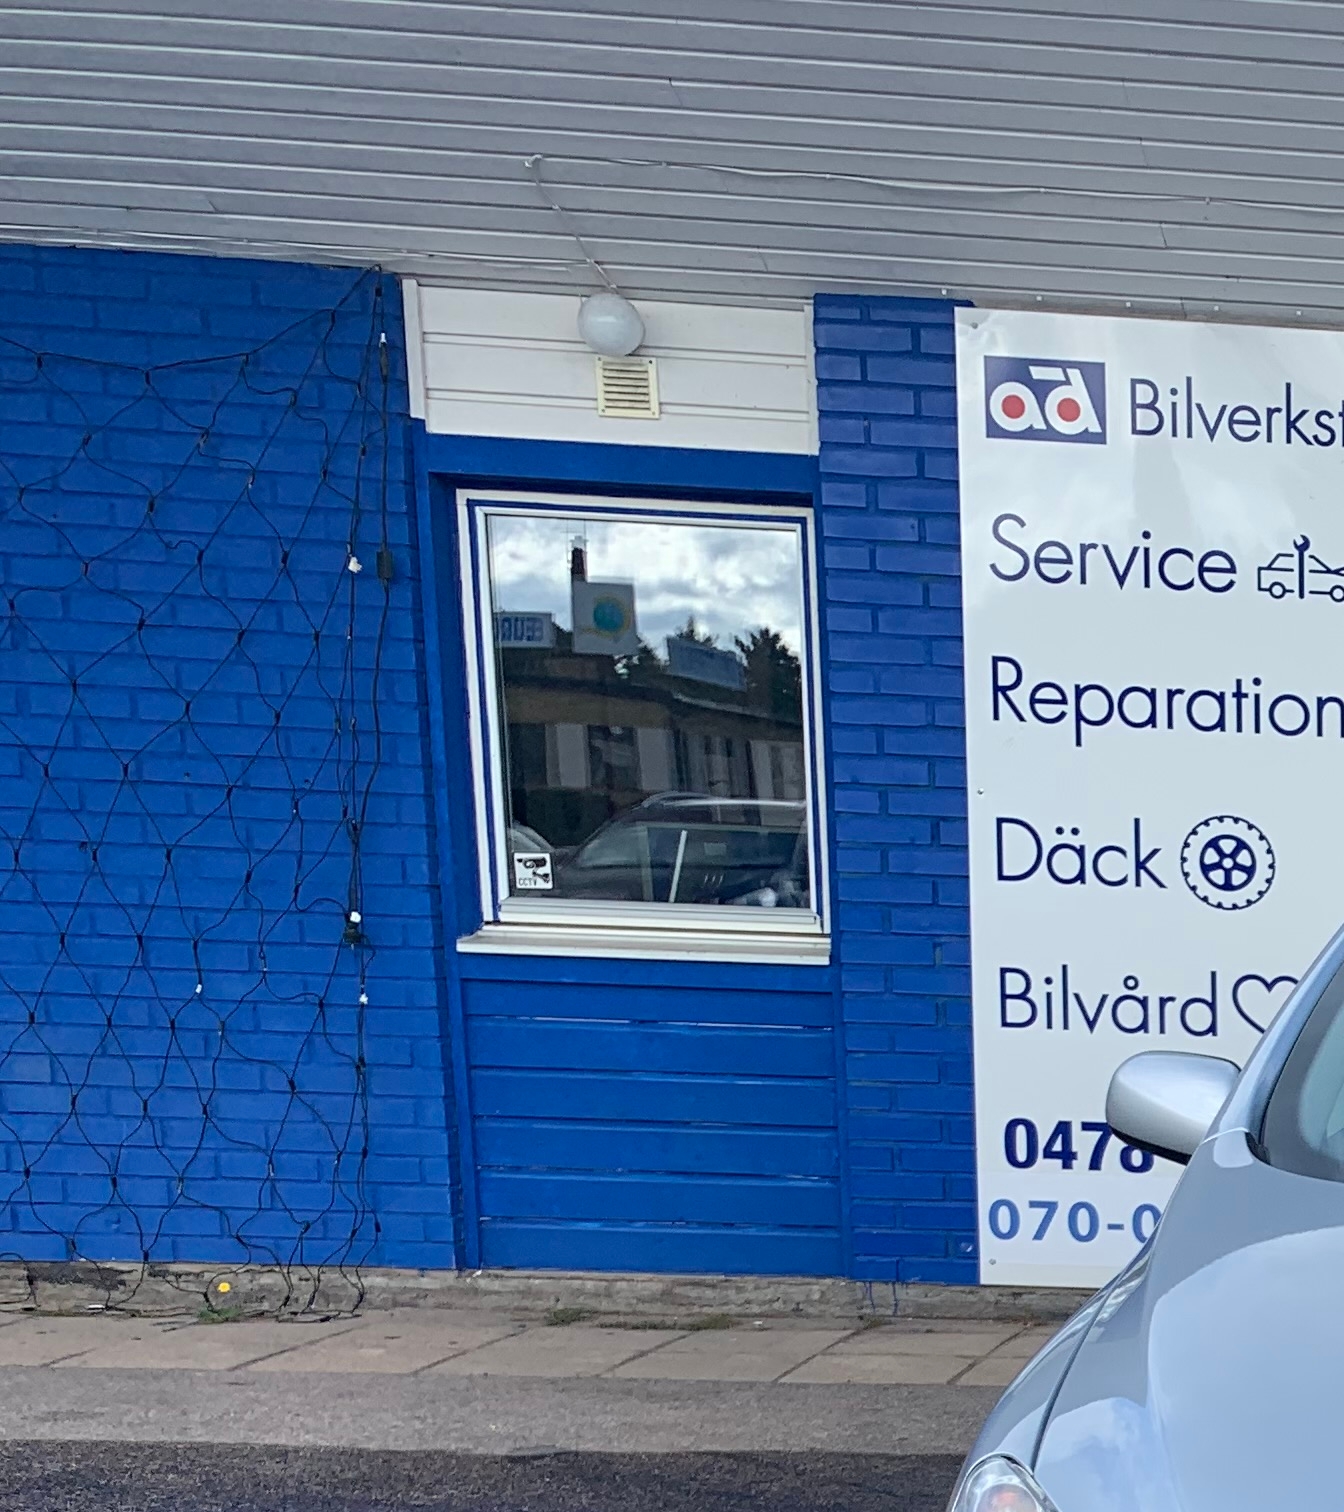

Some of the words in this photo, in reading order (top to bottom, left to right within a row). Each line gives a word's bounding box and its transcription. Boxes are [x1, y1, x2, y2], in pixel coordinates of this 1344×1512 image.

[989, 513, 1237, 593] Service
[995, 816, 1168, 889] Däck
[999, 963, 1218, 1037] Bilvård
